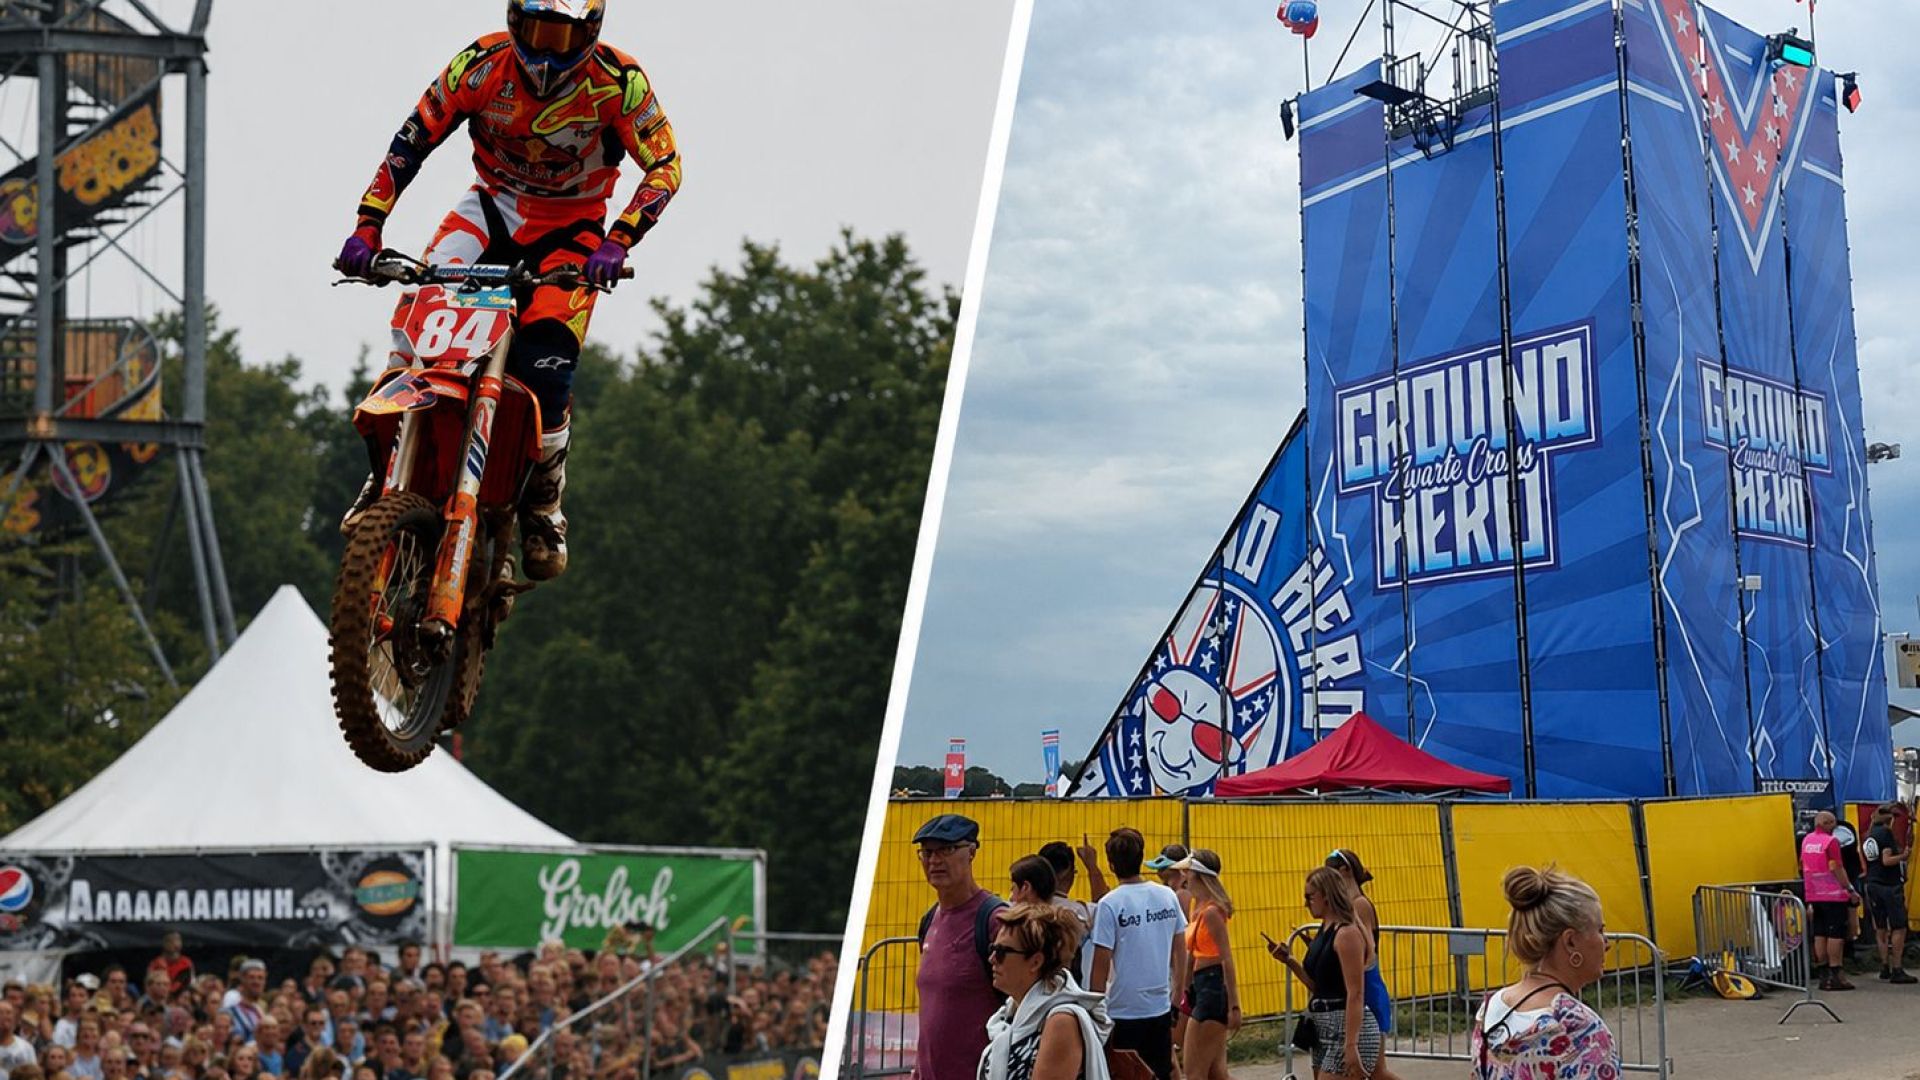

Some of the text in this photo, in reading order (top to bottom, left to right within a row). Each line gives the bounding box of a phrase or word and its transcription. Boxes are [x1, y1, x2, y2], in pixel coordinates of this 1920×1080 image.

[415, 309, 498, 358] 84
[1342, 337, 1587, 483] GROUND
[1702, 366, 1828, 466] GROUND
[1382, 472, 1545, 578] HERO
[1734, 466, 1807, 539] HERO
[1271, 547, 1364, 729] HERO
[538, 858, 672, 942] Grolsch
